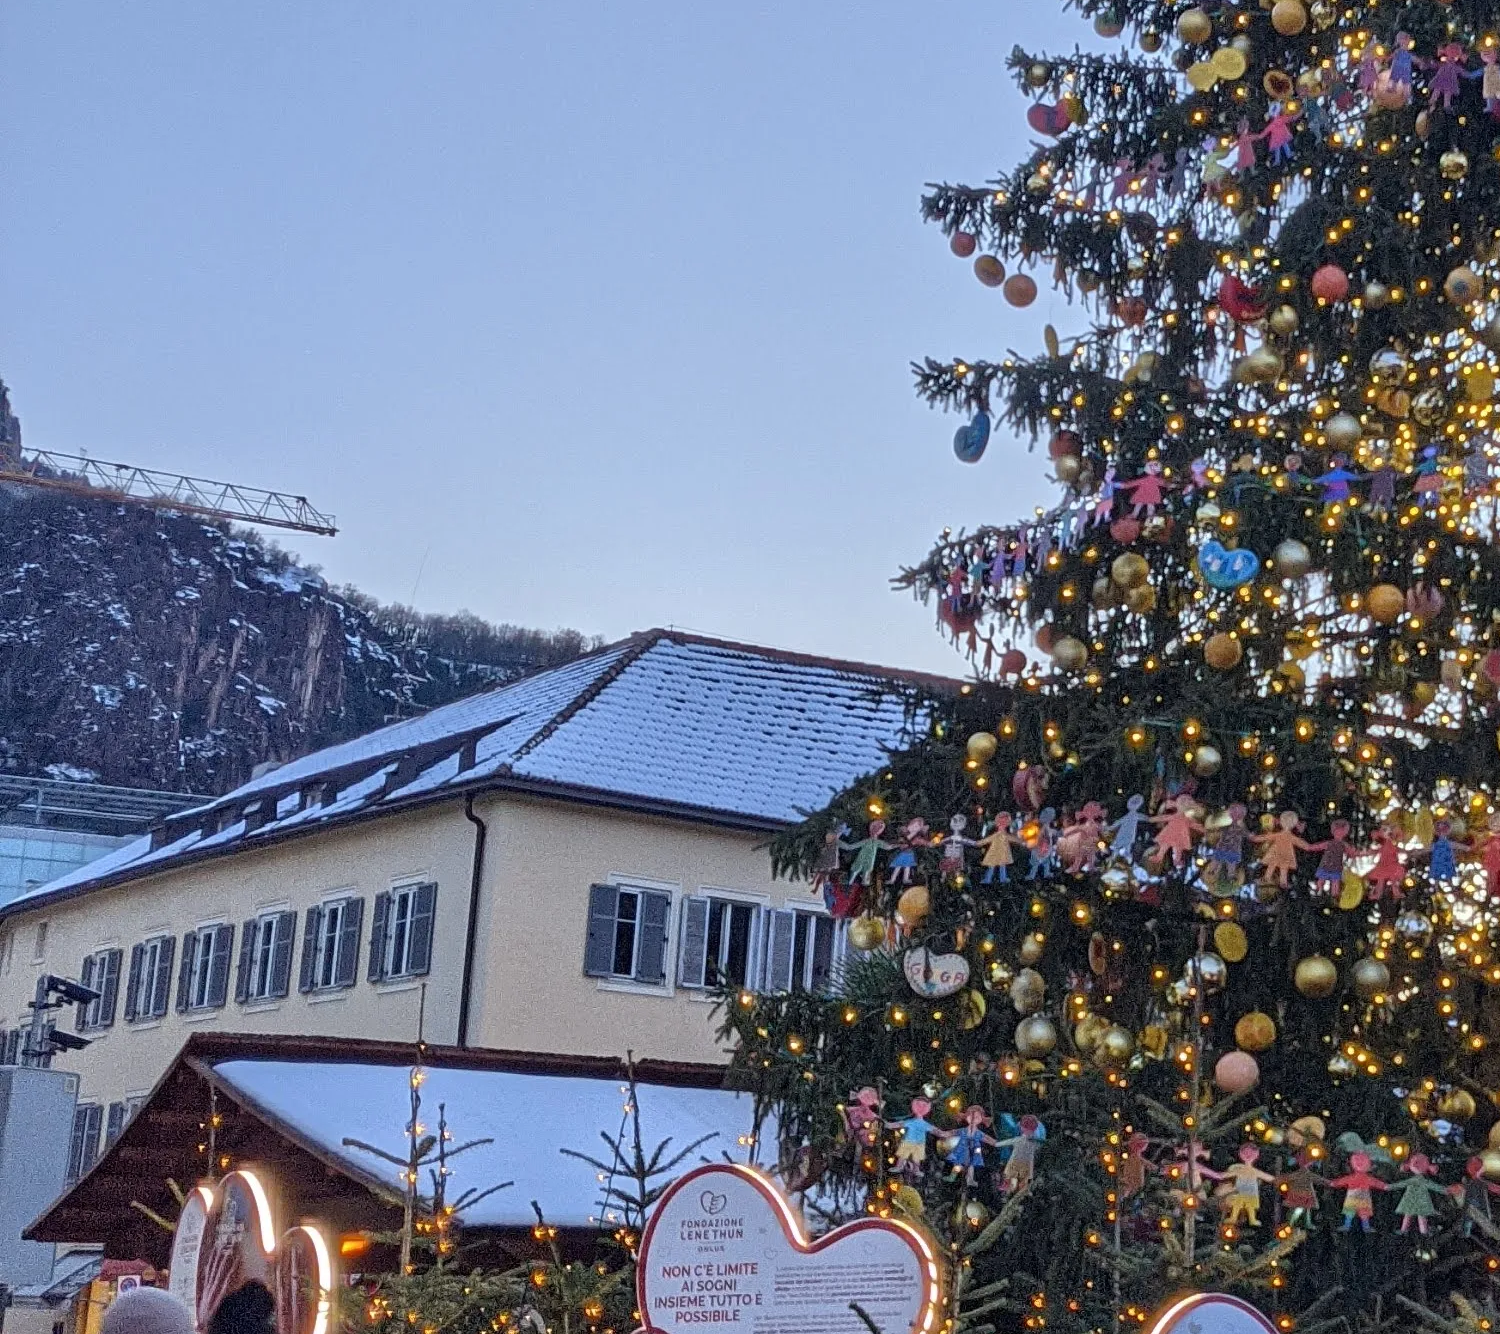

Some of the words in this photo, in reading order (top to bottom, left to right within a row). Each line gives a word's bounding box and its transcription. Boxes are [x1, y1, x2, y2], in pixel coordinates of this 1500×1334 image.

[681, 1218, 743, 1228] FONDAZIONE
[680, 1230, 710, 1241] LENE
[712, 1229, 743, 1240] THUN
[662, 1265, 691, 1278] NON
[694, 1262, 713, 1276] C'È
[717, 1263, 758, 1276] LIMITE
[681, 1280, 694, 1292] AI
[697, 1279, 737, 1292] SOGNI
[654, 1295, 706, 1309] INSIEME
[709, 1294, 752, 1307] TUTTO
[675, 1309, 741, 1323] POSSIBILE
